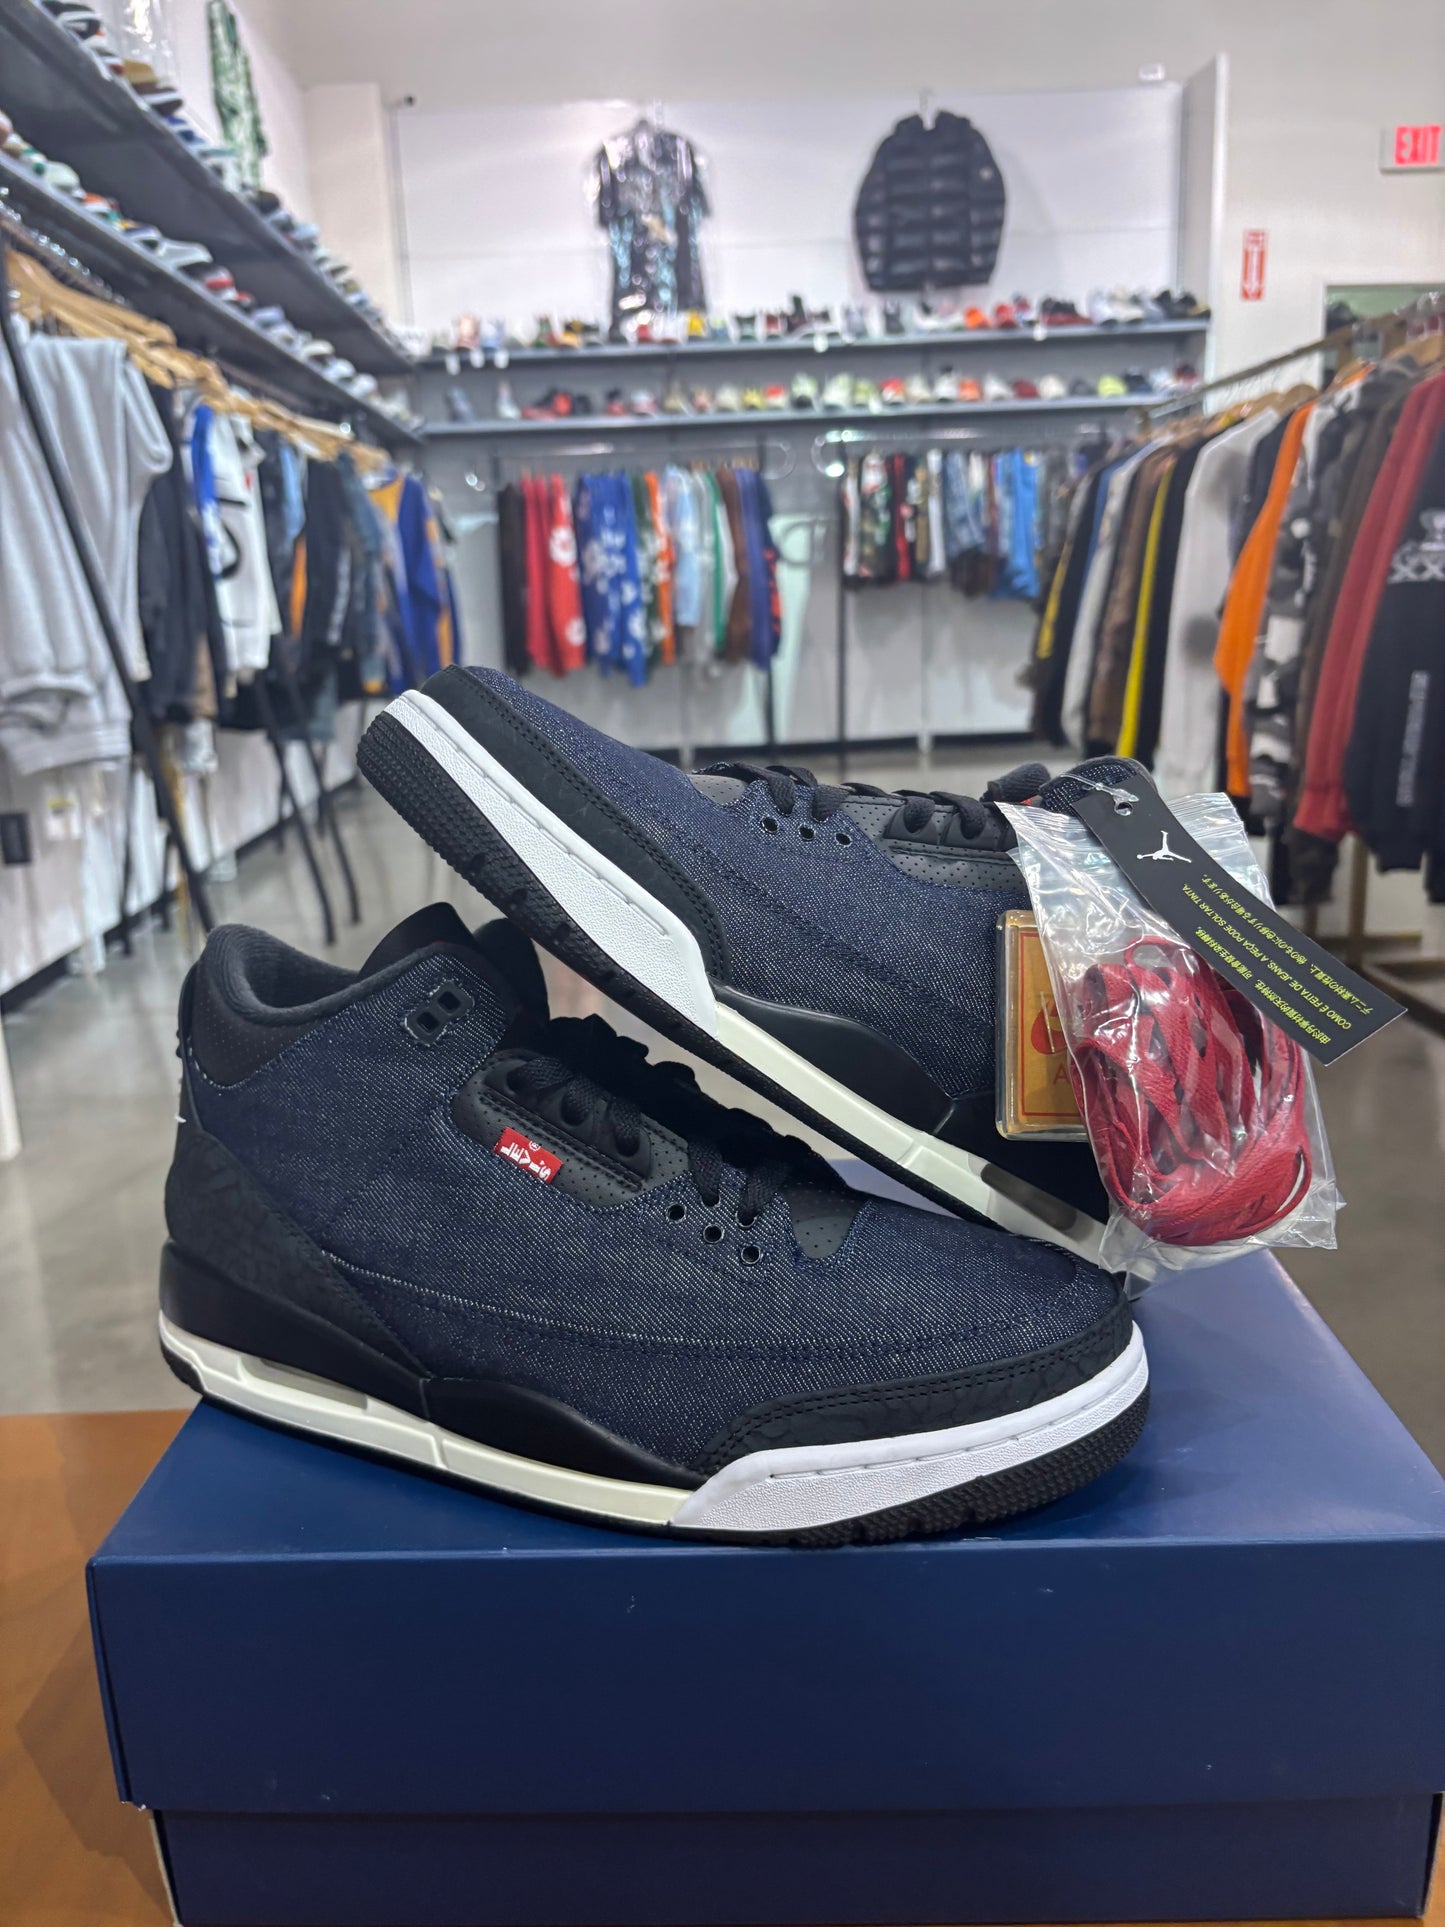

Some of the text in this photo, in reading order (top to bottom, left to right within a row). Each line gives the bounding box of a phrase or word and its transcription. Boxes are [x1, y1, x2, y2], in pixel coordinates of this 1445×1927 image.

[1394, 125, 1442, 166] EXIT
[1182, 883, 1201, 904] TINTA.
[1199, 903, 1226, 927] SOLTAR
[1223, 925, 1243, 943] PODE
[1242, 940, 1262, 958] PEÇA
[1267, 960, 1292, 982] JEANS,
[1288, 980, 1303, 991] DE
[1299, 988, 1323, 1008] FEITA
[1326, 1010, 1352, 1030] COMO
